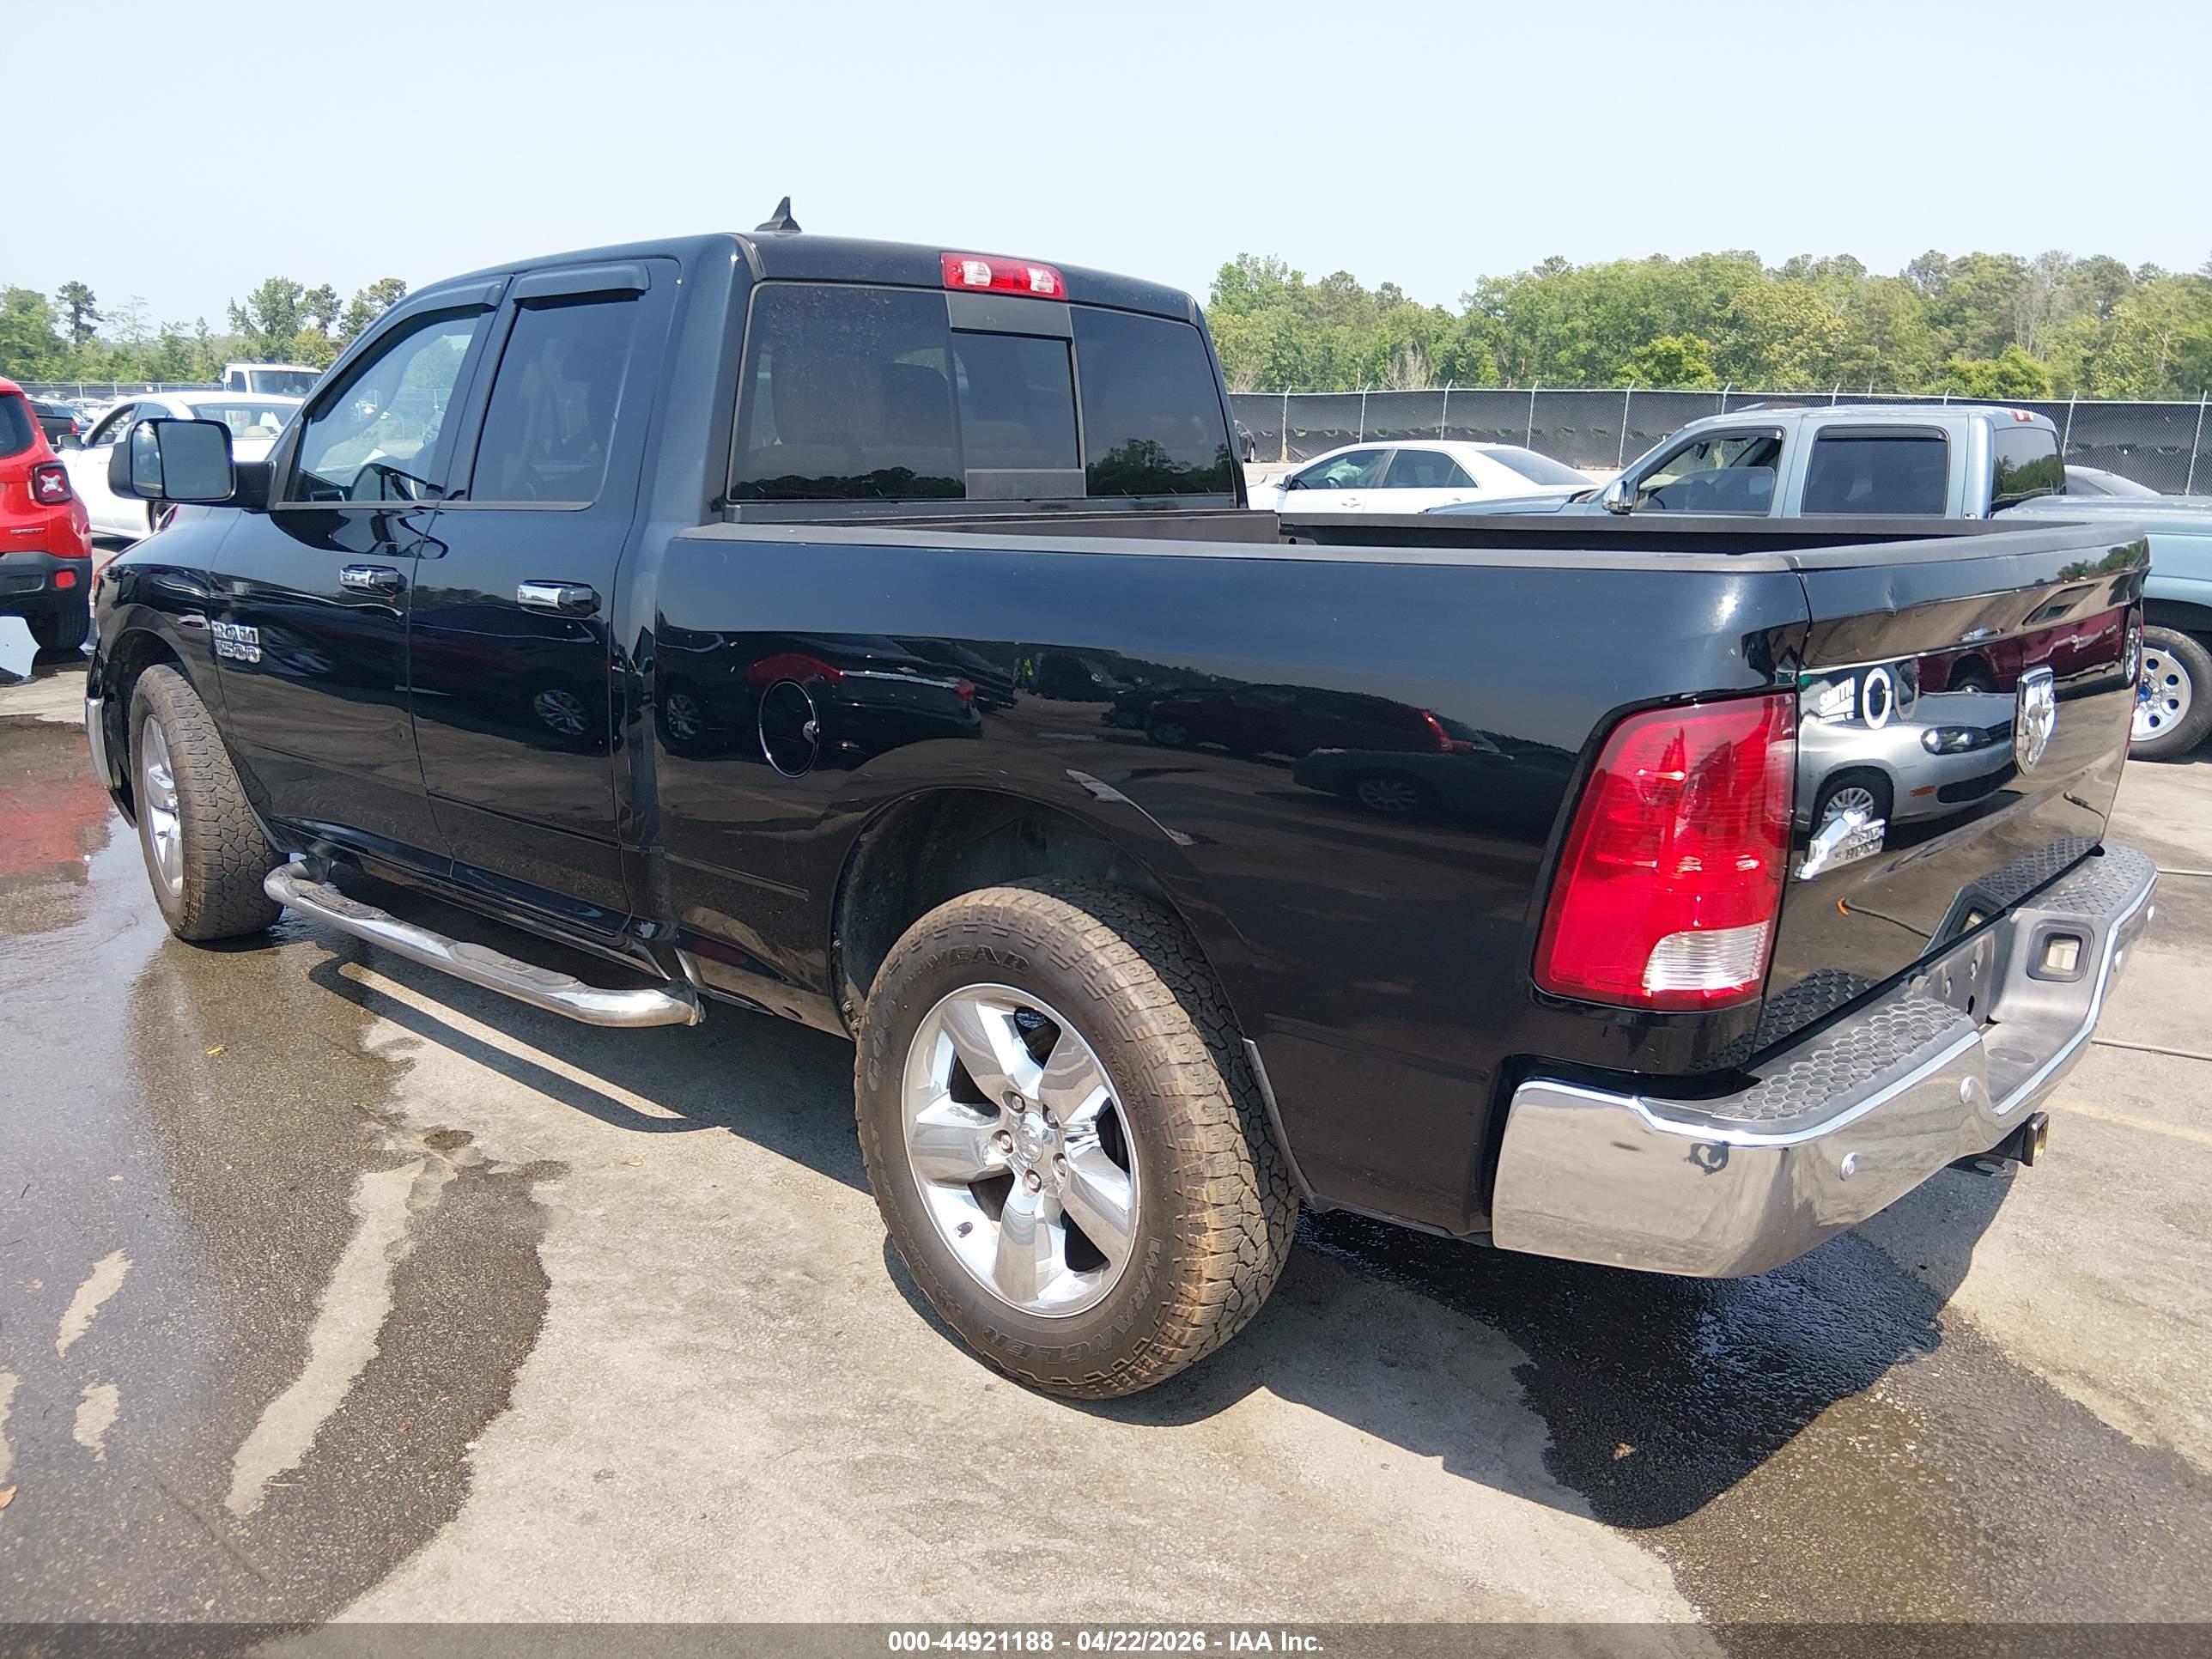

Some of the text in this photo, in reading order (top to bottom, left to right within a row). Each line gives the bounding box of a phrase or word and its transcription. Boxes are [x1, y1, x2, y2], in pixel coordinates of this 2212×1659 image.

[211, 620, 259, 644] RAM
[215, 639, 262, 664] 1500
[1819, 676, 1855, 713] SMITH
[981, 1237, 1162, 1365] WRANGLER
